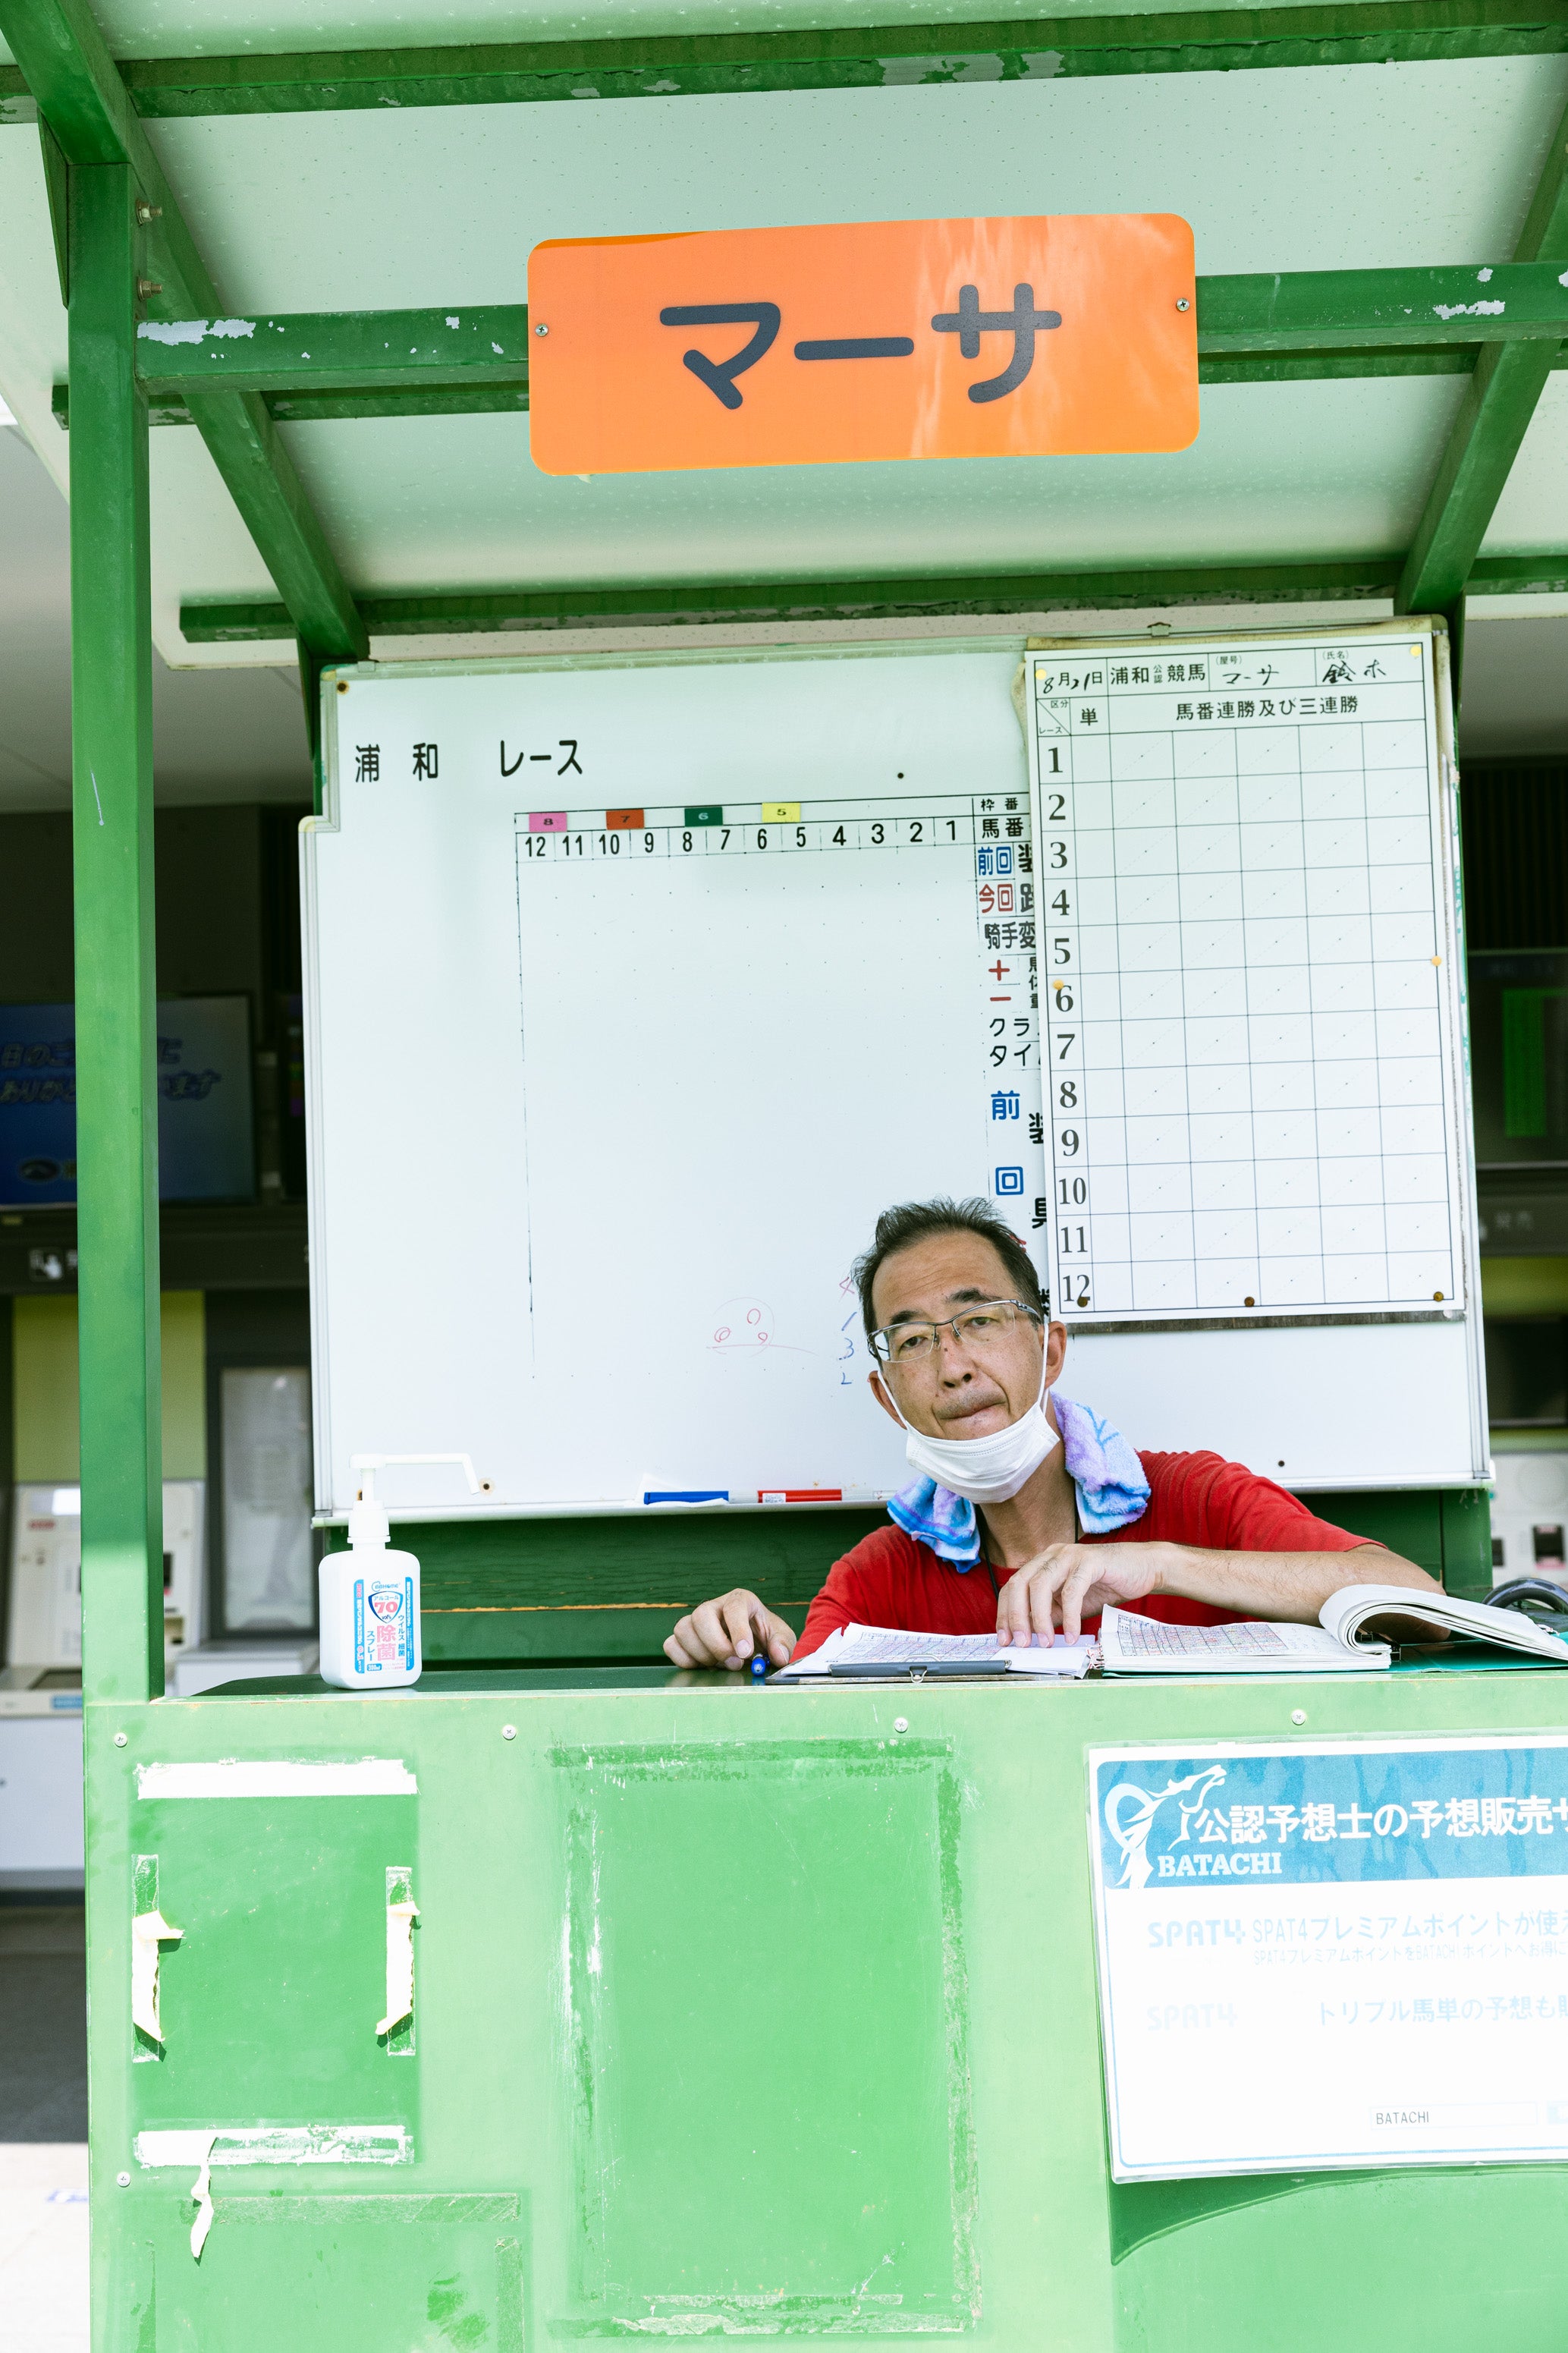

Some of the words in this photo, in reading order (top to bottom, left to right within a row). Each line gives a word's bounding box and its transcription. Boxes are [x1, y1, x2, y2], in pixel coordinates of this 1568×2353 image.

[659, 282, 1062, 411] マーサ
[1222, 664, 1280, 685] マーサ
[1051, 699, 1069, 709] 区分
[1080, 708, 1098, 726] 単
[1177, 695, 1358, 721] 馬番連勝及び三連勝
[1039, 726, 1063, 735] レース
[501, 740, 583, 776] レース
[1048, 747, 1063, 774] 1
[620, 815, 630, 823] 7
[698, 812, 709, 820] 6
[1048, 794, 1066, 820] 2
[525, 836, 545, 857] 12
[562, 835, 583, 856] 11
[599, 834, 619, 854] 10
[645, 832, 654, 853] 9
[683, 832, 692, 852] 8
[721, 829, 731, 850] 7
[758, 829, 767, 849] 6
[796, 826, 806, 847] 5
[832, 826, 847, 846] 4
[872, 823, 885, 844] 3
[910, 822, 922, 842] 2
[946, 820, 955, 841] 1
[982, 816, 1024, 839] 馬番
[978, 846, 1012, 876] 前回
[1051, 841, 1067, 868] 3
[979, 883, 1013, 914] 今回
[1051, 889, 1070, 916] 4
[1054, 938, 1070, 964] 5
[1056, 985, 1073, 1011] 6
[989, 1018, 1039, 1037] クラ
[989, 1044, 1040, 1067] タイ
[1057, 1034, 1075, 1059] 7
[1060, 1081, 1077, 1108] 8
[1061, 1129, 1079, 1156] 9
[1058, 1177, 1086, 1204] 10
[1061, 1226, 1088, 1253] 11
[1063, 1275, 1090, 1302] 12
[374, 1601, 398, 1613] 70
[377, 1625, 396, 1661] 除菌
[1158, 1851, 1282, 1878] BATACHI
[1148, 1918, 1246, 1948] SPAT4
[1375, 2112, 1429, 2125] BATACHI
